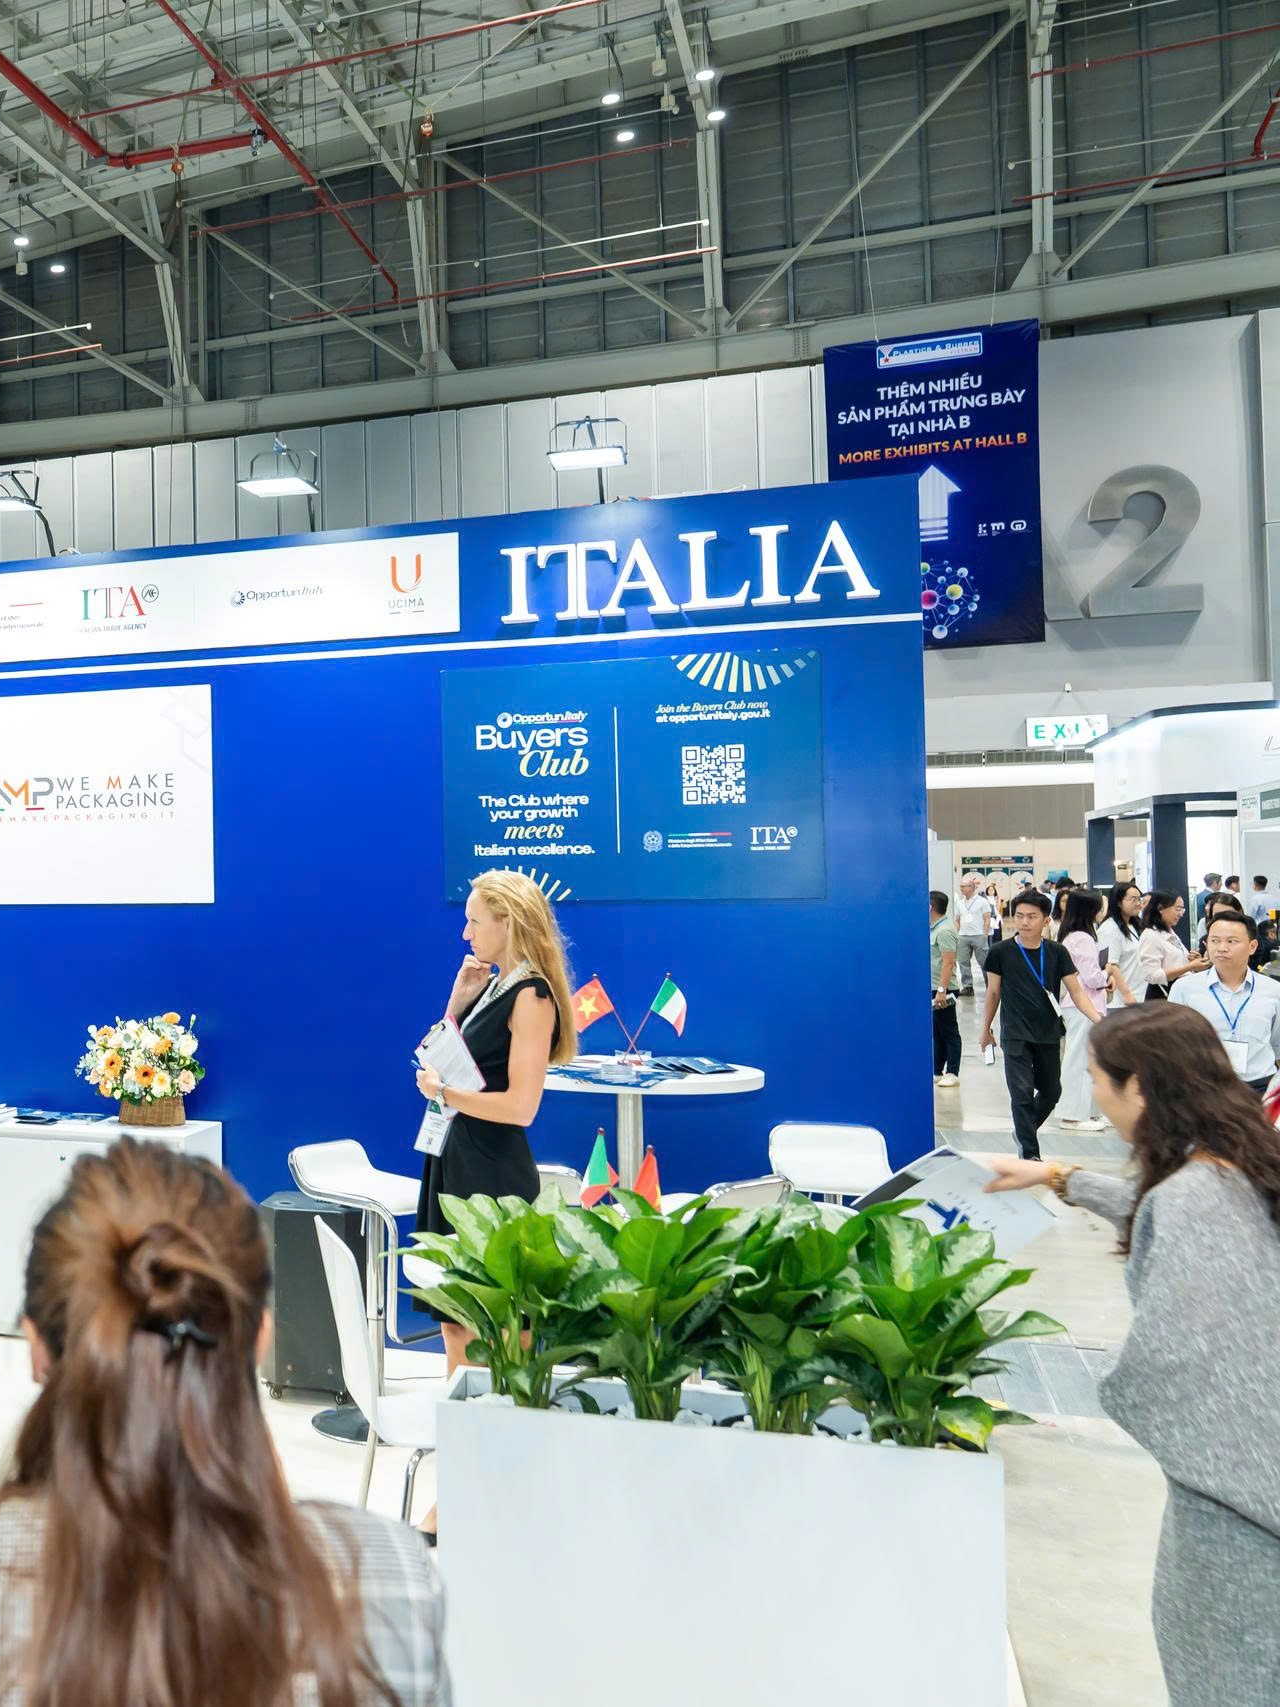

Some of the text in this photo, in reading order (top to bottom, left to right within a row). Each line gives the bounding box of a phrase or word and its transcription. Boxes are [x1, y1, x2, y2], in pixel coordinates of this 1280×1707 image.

[877, 381, 926, 401] THÊM
[837, 388, 1026, 425] SẢN PHẨM TRƯNG BÀY
[888, 415, 971, 440] TẠI NHÀ B
[838, 432, 1028, 465] MORE EXHIBITS AT HALL B
[1045, 464, 1205, 622] 2
[500, 519, 880, 624] ITALIA
[80, 585, 147, 620] ITA
[388, 597, 425, 609] UCIMA
[123, 623, 147, 631] AGENCY
[656, 700, 769, 714] Join the Buyers Club now
[656, 708, 771, 723] at opportunitaly.gov.it
[475, 724, 589, 755] Buyers
[519, 748, 589, 778] Club
[56, 776, 89, 791] WE
[106, 773, 174, 790] MAKE
[56, 791, 175, 809] PACKAGING
[478, 793, 589, 808] The Club where
[490, 806, 579, 822] your growth
[503, 823, 565, 840] meets
[750, 826, 791, 845] ITA
[474, 842, 596, 857] Italian excellence.
